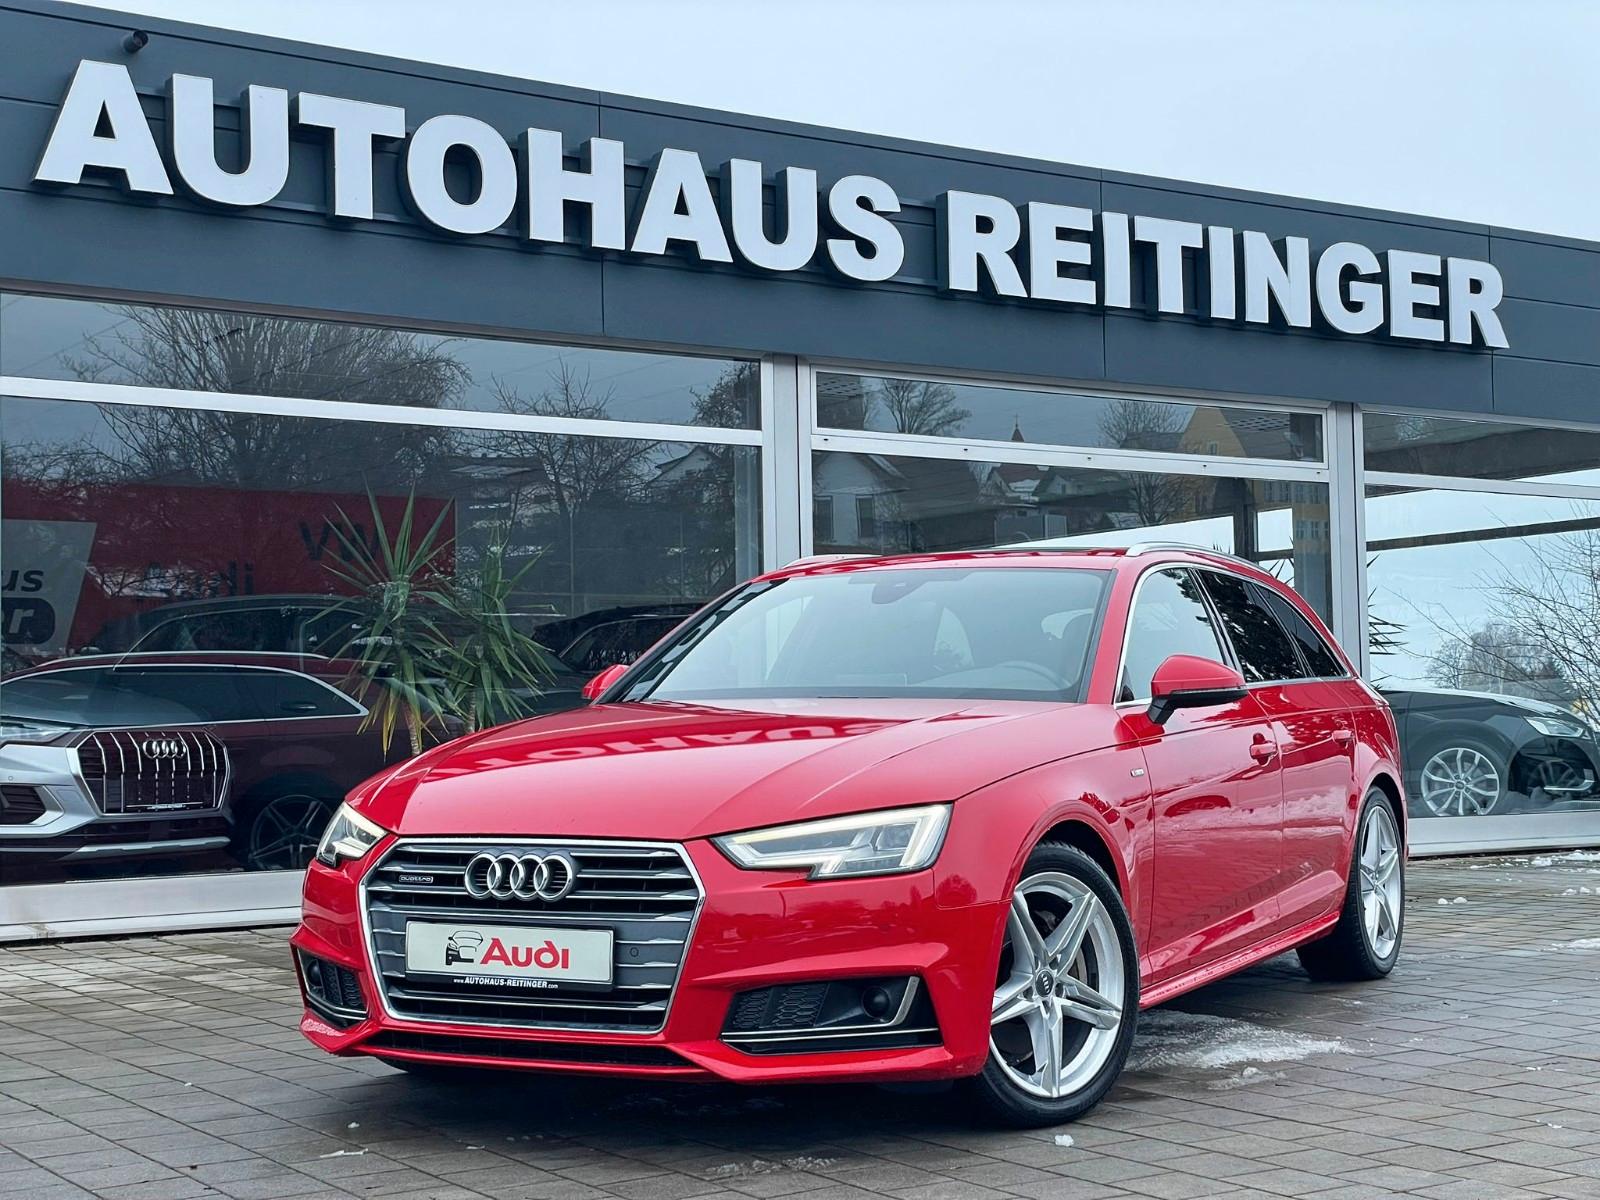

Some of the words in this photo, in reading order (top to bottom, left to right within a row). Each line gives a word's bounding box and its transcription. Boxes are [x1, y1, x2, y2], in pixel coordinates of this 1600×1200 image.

[34, 59, 905, 282] AUTOHAUS
[946, 188, 1510, 350] REITINGER
[480, 937, 569, 969] Audi
